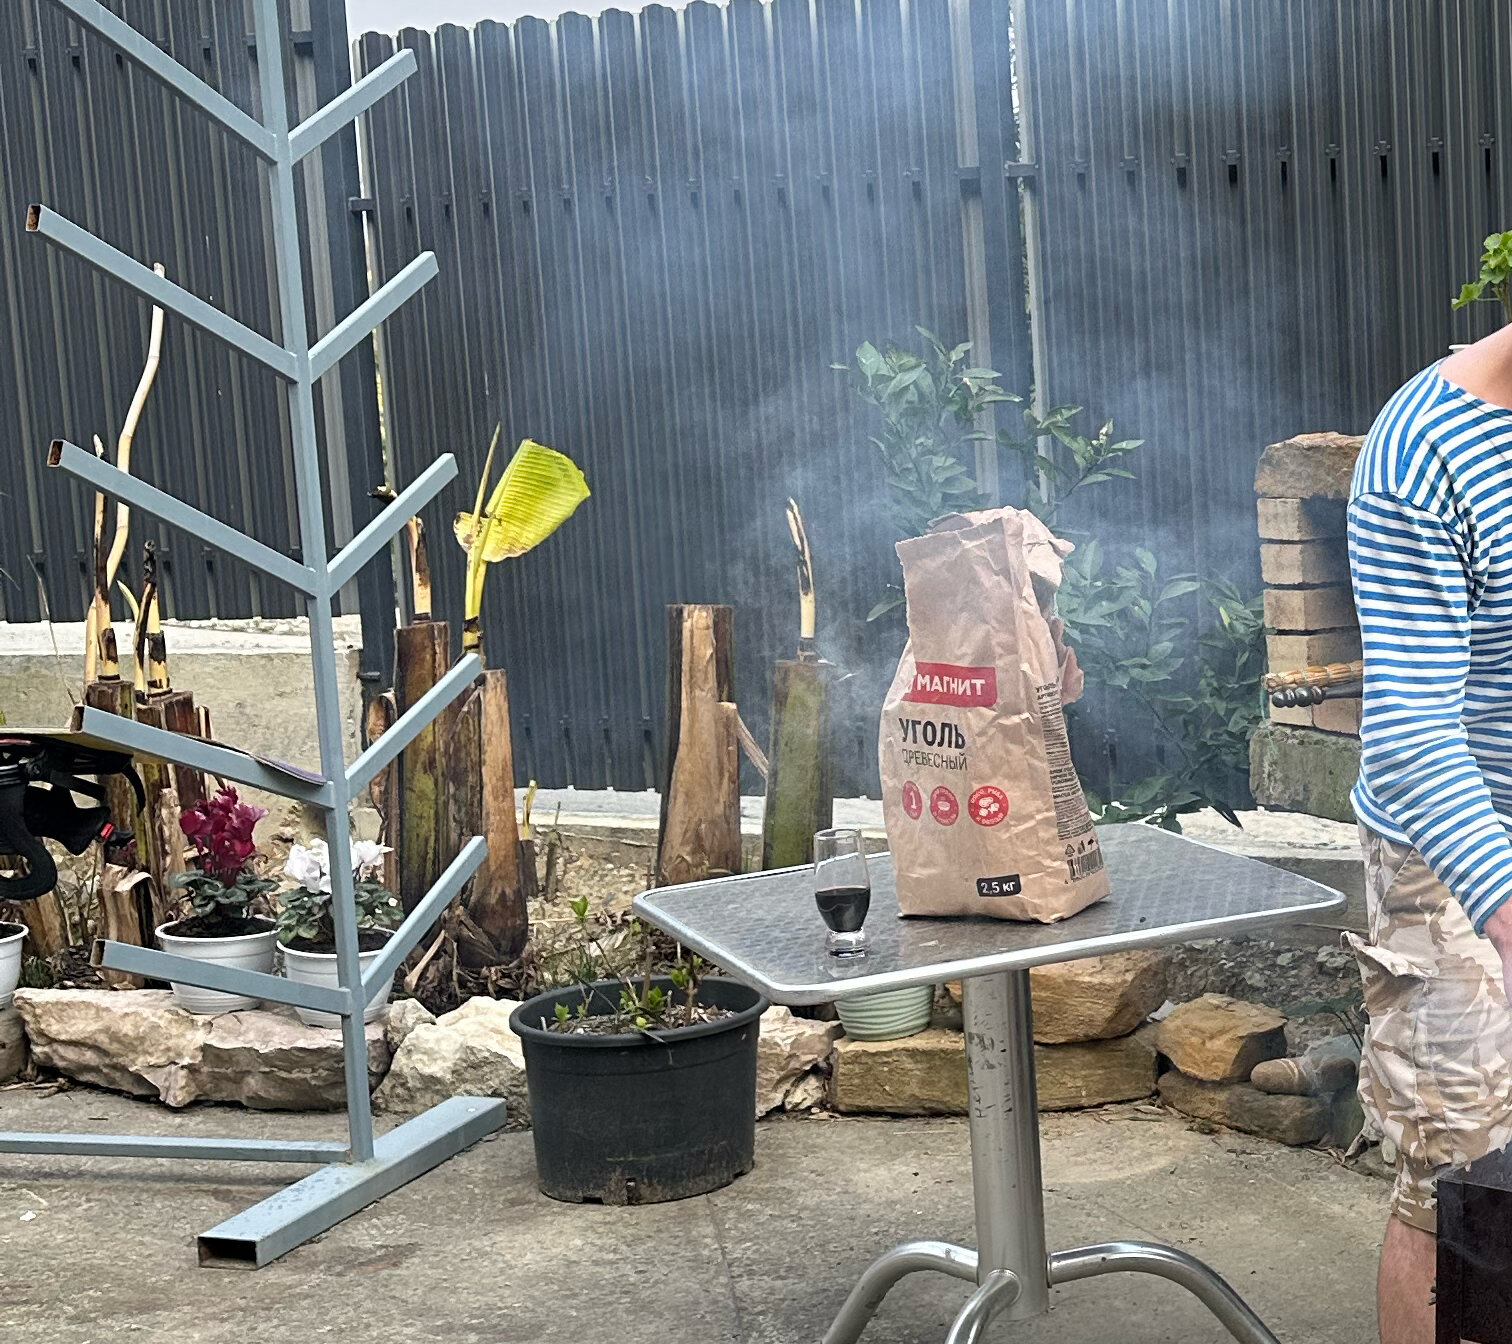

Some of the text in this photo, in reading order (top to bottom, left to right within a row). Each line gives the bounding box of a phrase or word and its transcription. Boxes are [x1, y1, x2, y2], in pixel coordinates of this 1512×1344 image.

[916, 673, 986, 696] МАГНИТ
[898, 717, 966, 749] УГОЛЬ
[901, 748, 968, 771] ДРЕВЕСНЫЙ
[910, 790, 918, 809] 1
[980, 881, 1000, 894] 2,5
